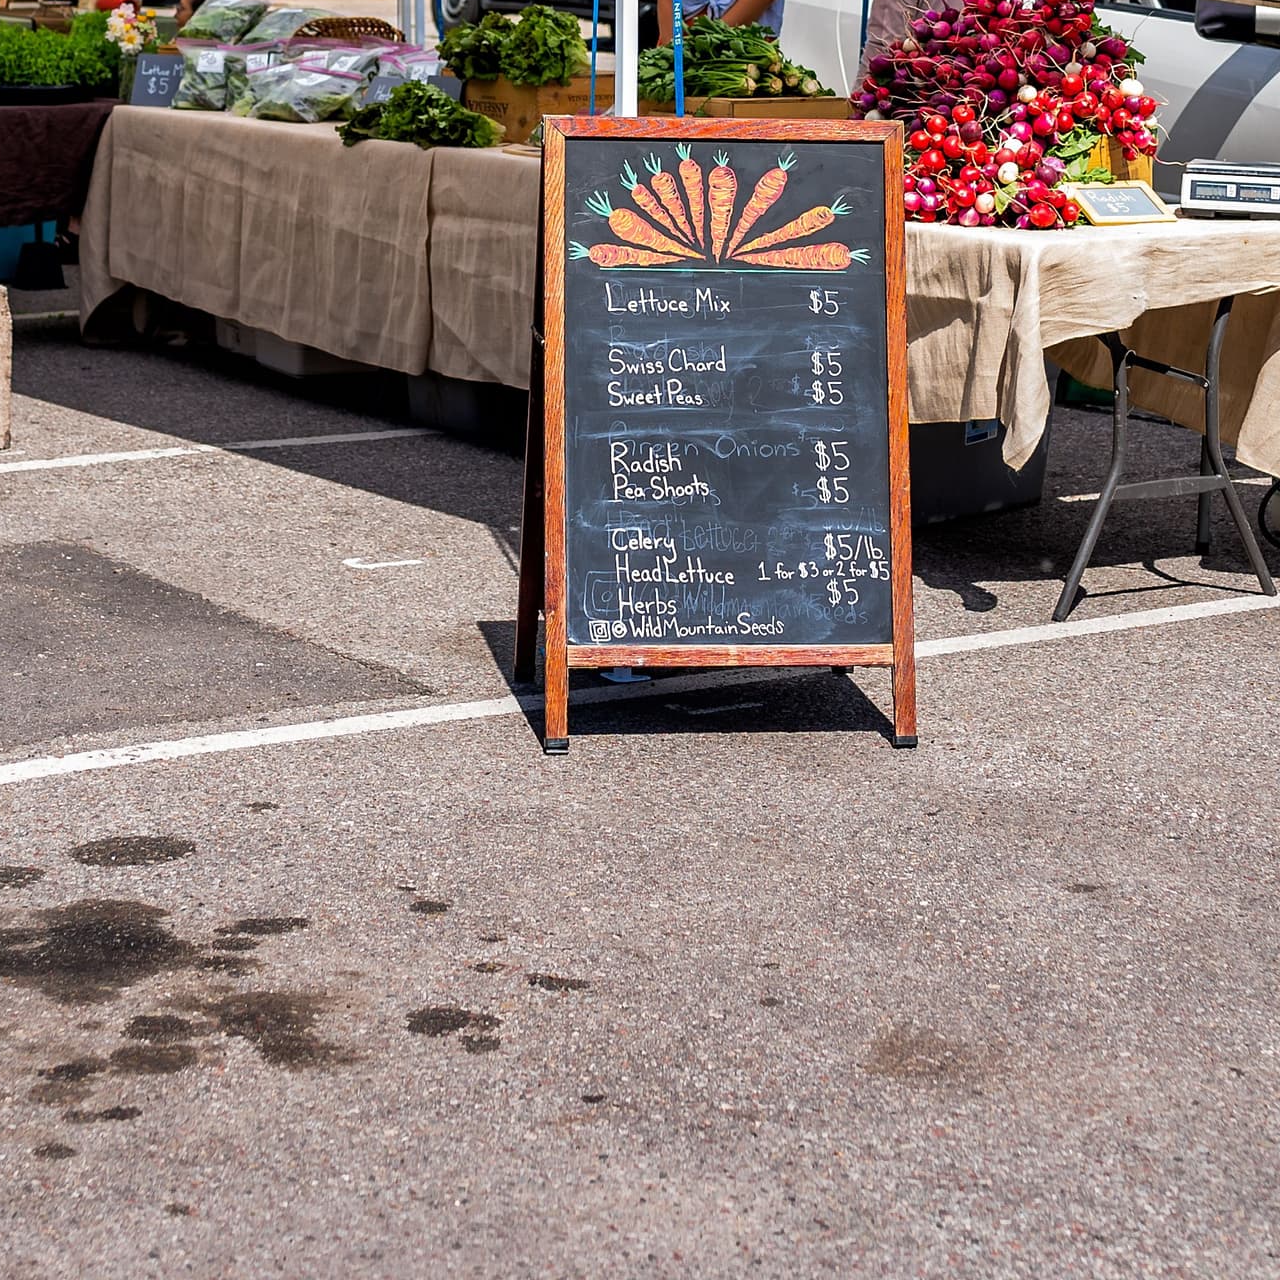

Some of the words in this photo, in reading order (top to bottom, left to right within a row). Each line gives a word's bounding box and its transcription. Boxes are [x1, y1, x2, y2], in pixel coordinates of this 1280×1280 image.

[147, 76, 170, 95] $5
[1106, 202, 1130, 214] $5
[605, 283, 689, 313] Lettuce
[695, 288, 731, 313] Mix
[808, 290, 840, 315] $5
[608, 349, 665, 376] Swiss
[668, 346, 727, 372] Chard
[811, 352, 843, 377] $5
[607, 381, 662, 407] Sweet
[666, 378, 704, 406] Peas
[812, 380, 844, 406] $5
[610, 441, 682, 475] Radish
[815, 440, 851, 472] $5
[613, 473, 646, 503] Pea
[651, 474, 710, 500] Shoots
[816, 476, 850, 504] $5
[611, 528, 677, 564] Celery
[824, 532, 887, 561] $5/lb.
[758, 561, 771, 581] 1
[774, 562, 795, 580] for
[798, 562, 819, 579] $3
[836, 561, 845, 577] 2
[849, 561, 867, 577] for
[869, 561, 891, 581] $5
[618, 587, 678, 625] Herbs
[826, 577, 859, 608] $5
